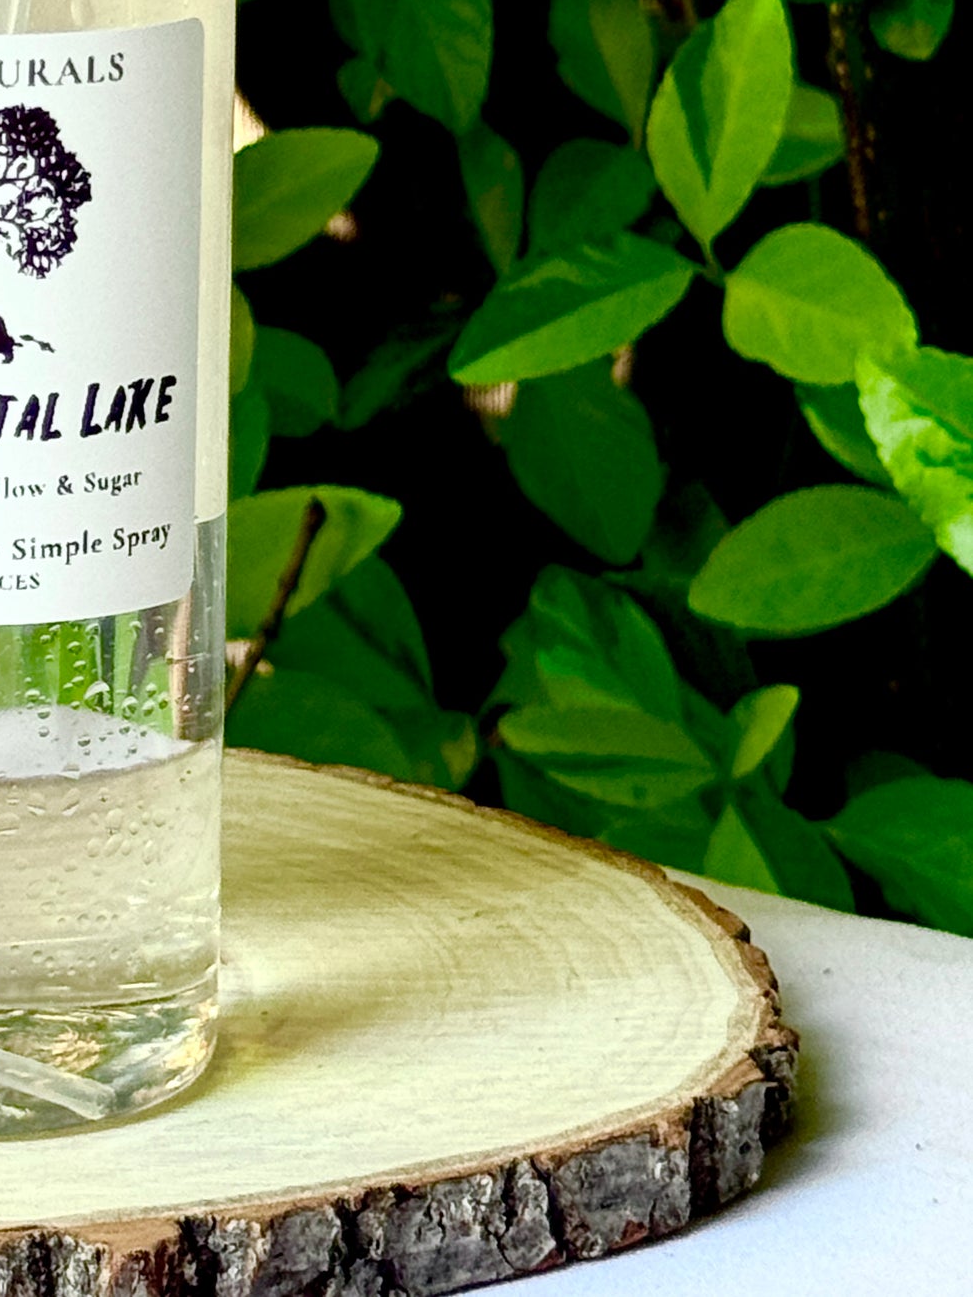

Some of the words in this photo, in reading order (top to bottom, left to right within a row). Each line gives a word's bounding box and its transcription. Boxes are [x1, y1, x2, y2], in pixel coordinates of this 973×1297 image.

[79, 374, 178, 439] LAKE
[56, 474, 75, 496] &
[83, 471, 143, 497] Sugar
[12, 530, 103, 565] Simple
[112, 523, 172, 556] Spray
